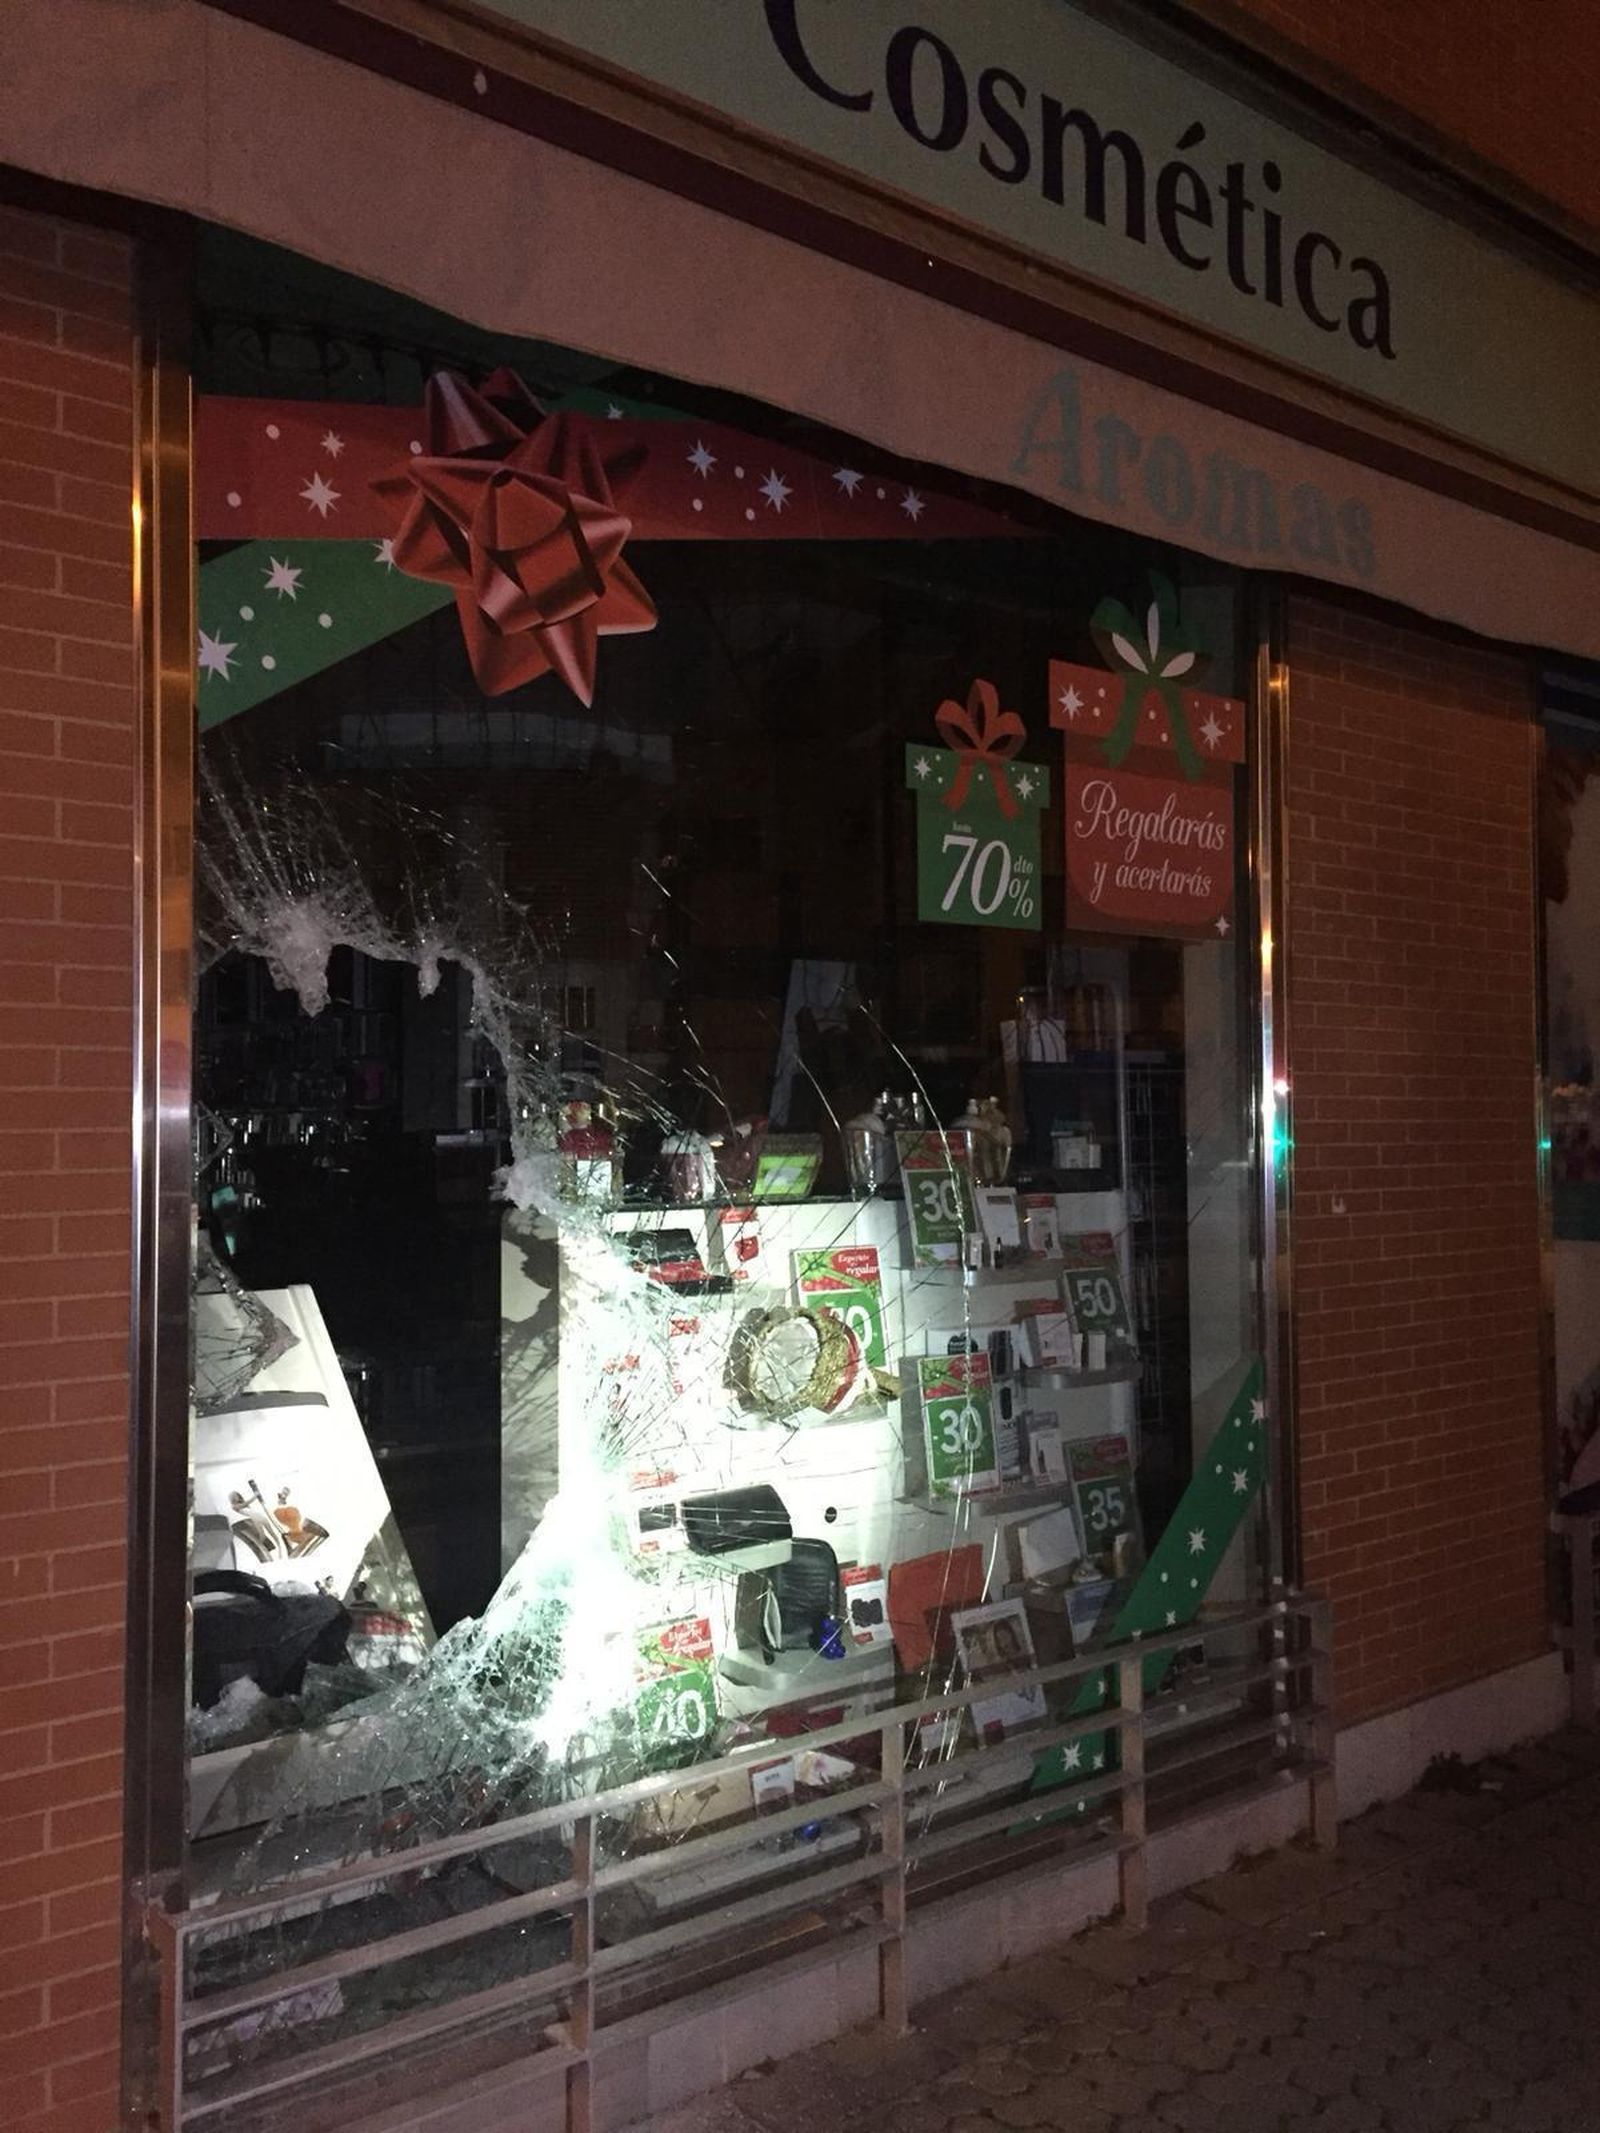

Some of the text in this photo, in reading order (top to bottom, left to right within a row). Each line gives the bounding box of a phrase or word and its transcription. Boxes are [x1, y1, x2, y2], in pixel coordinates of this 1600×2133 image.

[764, 0, 1396, 360] Cosmética
[1009, 369, 1376, 577] Aromas
[1075, 780, 1225, 862] Regalarás
[1090, 859, 1212, 903] y acertarás
[919, 1179, 962, 1222] 30
[1077, 1278, 1116, 1317] 50
[939, 1405, 982, 1454] 30
[1088, 1487, 1125, 1530] 35
